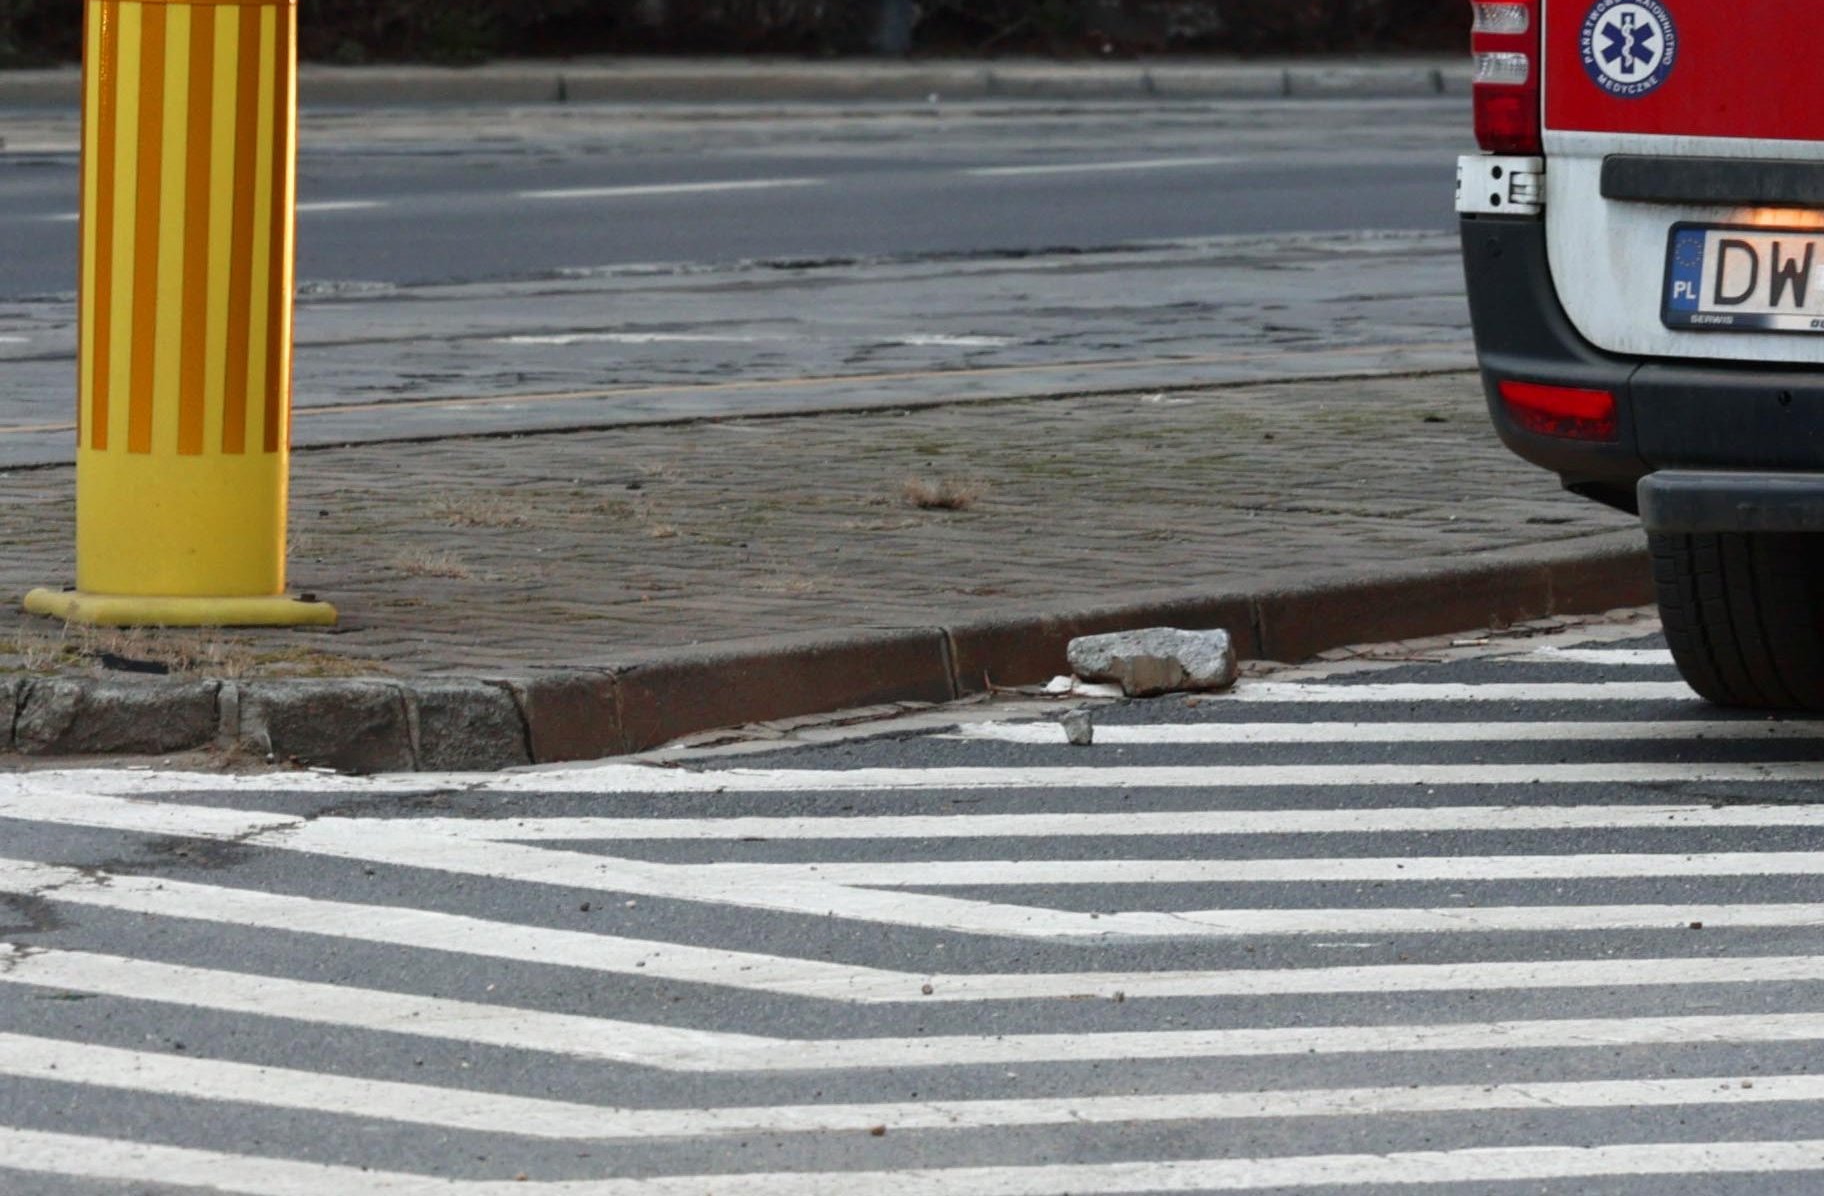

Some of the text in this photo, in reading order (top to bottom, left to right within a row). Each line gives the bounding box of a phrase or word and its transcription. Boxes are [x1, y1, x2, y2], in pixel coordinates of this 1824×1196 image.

[1597, 74, 1658, 94] MEDYCZNE
[1713, 238, 1814, 308] DW
[1673, 281, 1696, 300] PL
[1690, 315, 1734, 325] SERWIS
